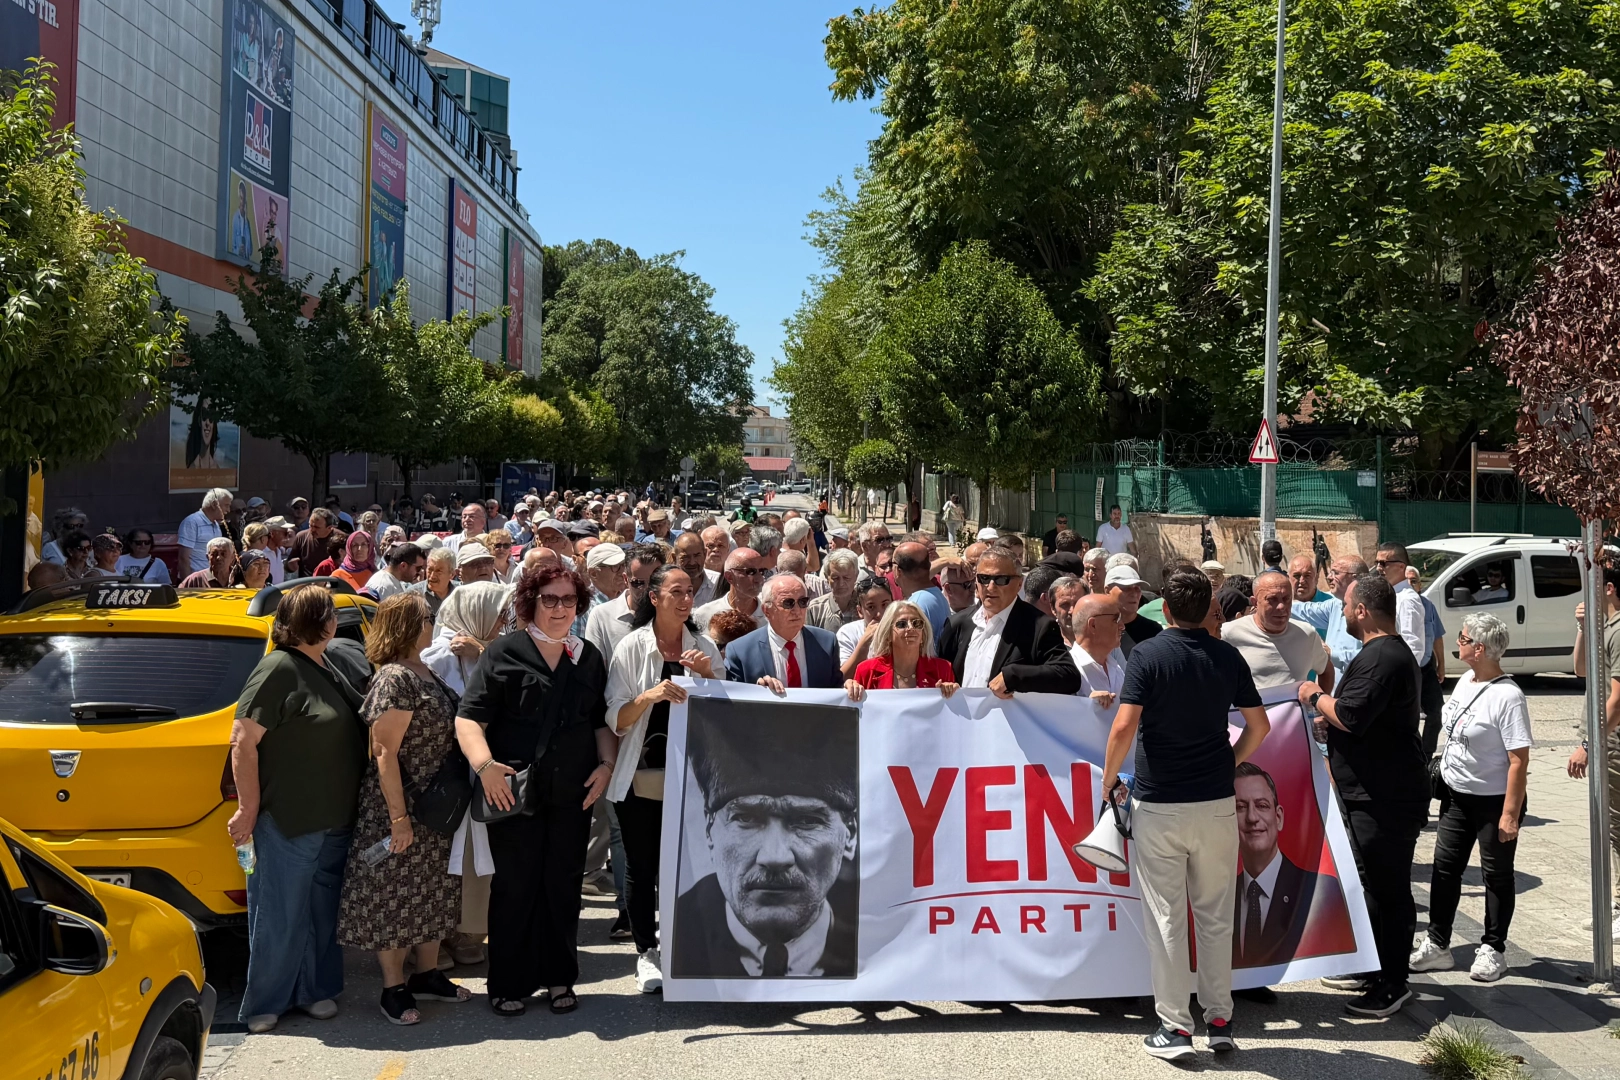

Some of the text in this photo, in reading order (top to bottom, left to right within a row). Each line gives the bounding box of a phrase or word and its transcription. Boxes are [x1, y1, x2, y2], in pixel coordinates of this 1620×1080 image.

[246, 112, 270, 150] D&R
[459, 199, 471, 226] FLO
[887, 762, 1131, 888] YEN
[82, 1031, 99, 1080] 46
